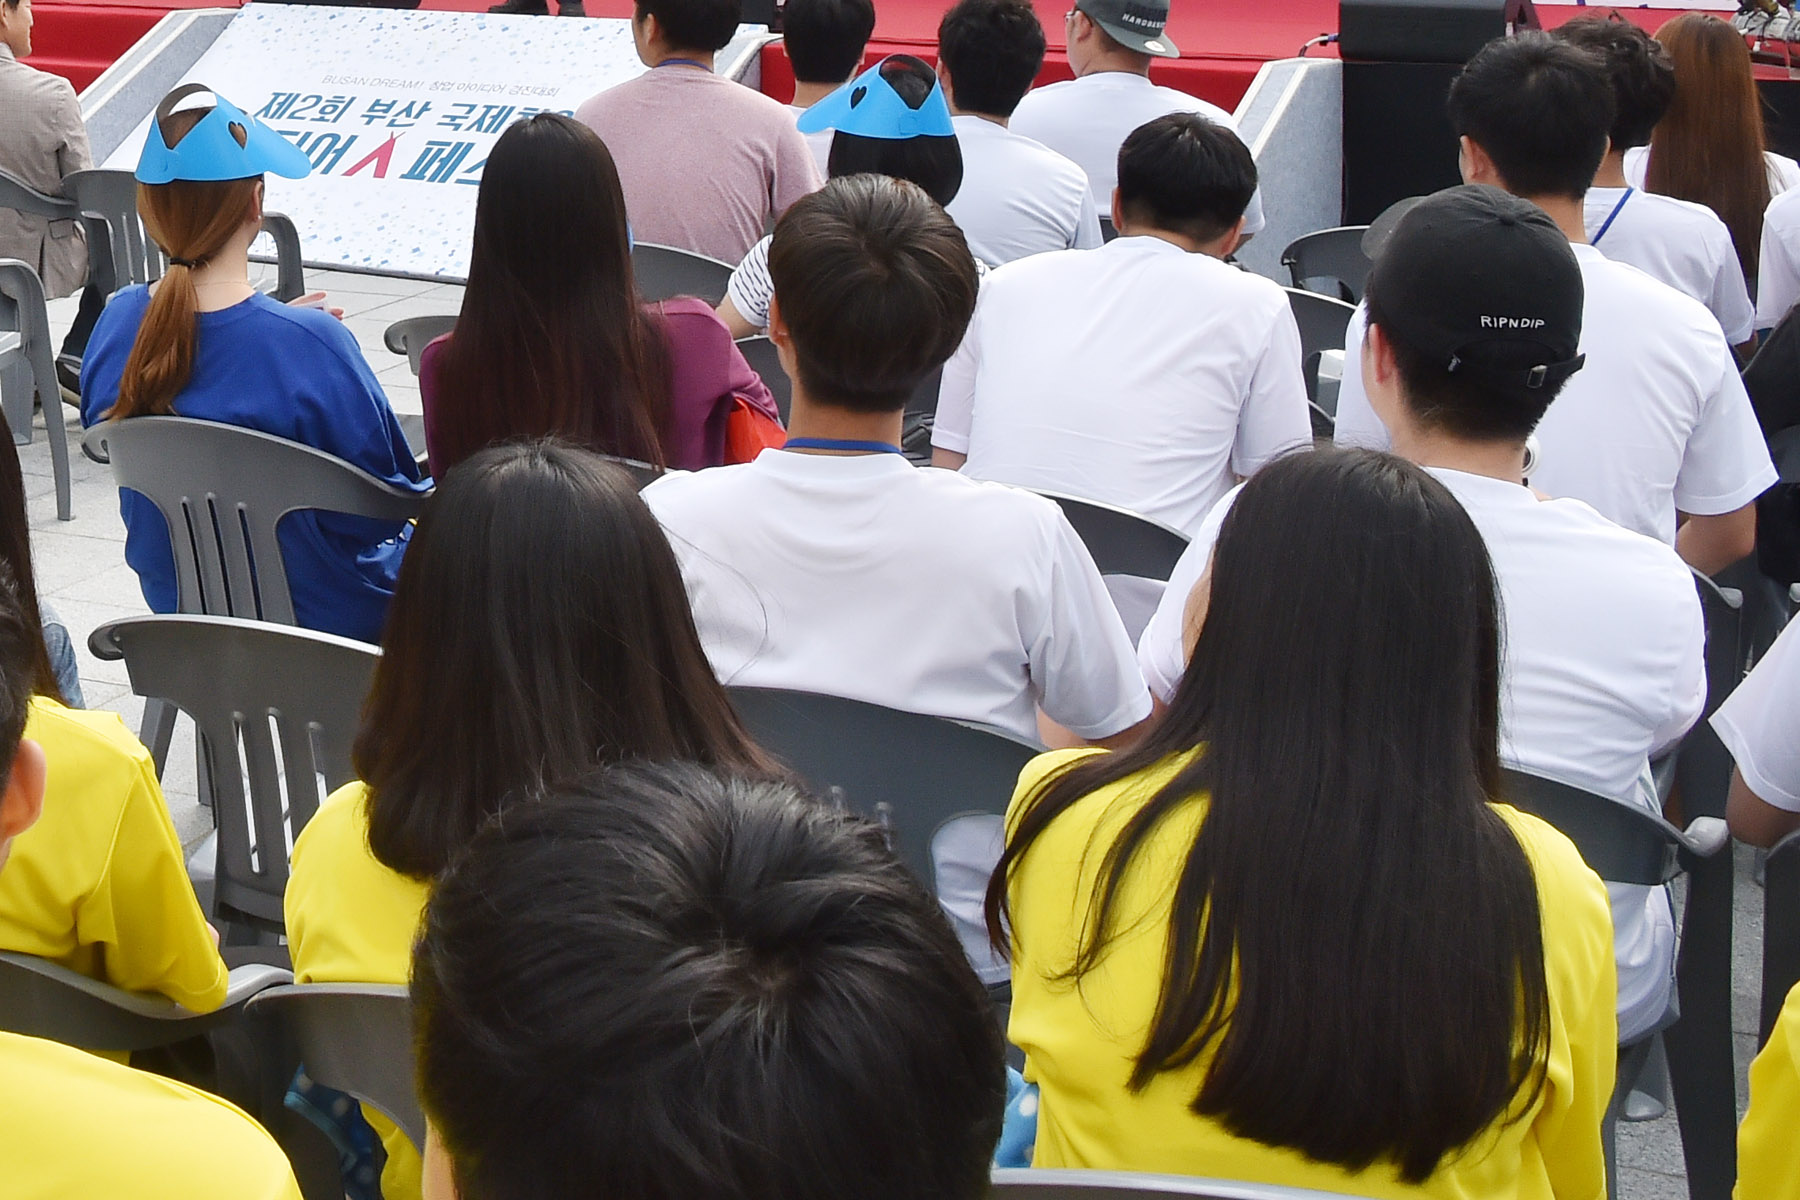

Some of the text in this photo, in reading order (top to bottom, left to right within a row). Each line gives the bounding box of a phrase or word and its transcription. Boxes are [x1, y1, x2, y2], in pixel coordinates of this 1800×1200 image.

[321, 74, 561, 98] BUSAN DREAM! 창업 아이디어 경진대회
[253, 91, 358, 124] 제2회
[358, 98, 433, 128] 부산
[1480, 315, 1546, 329] RIPNDIP
